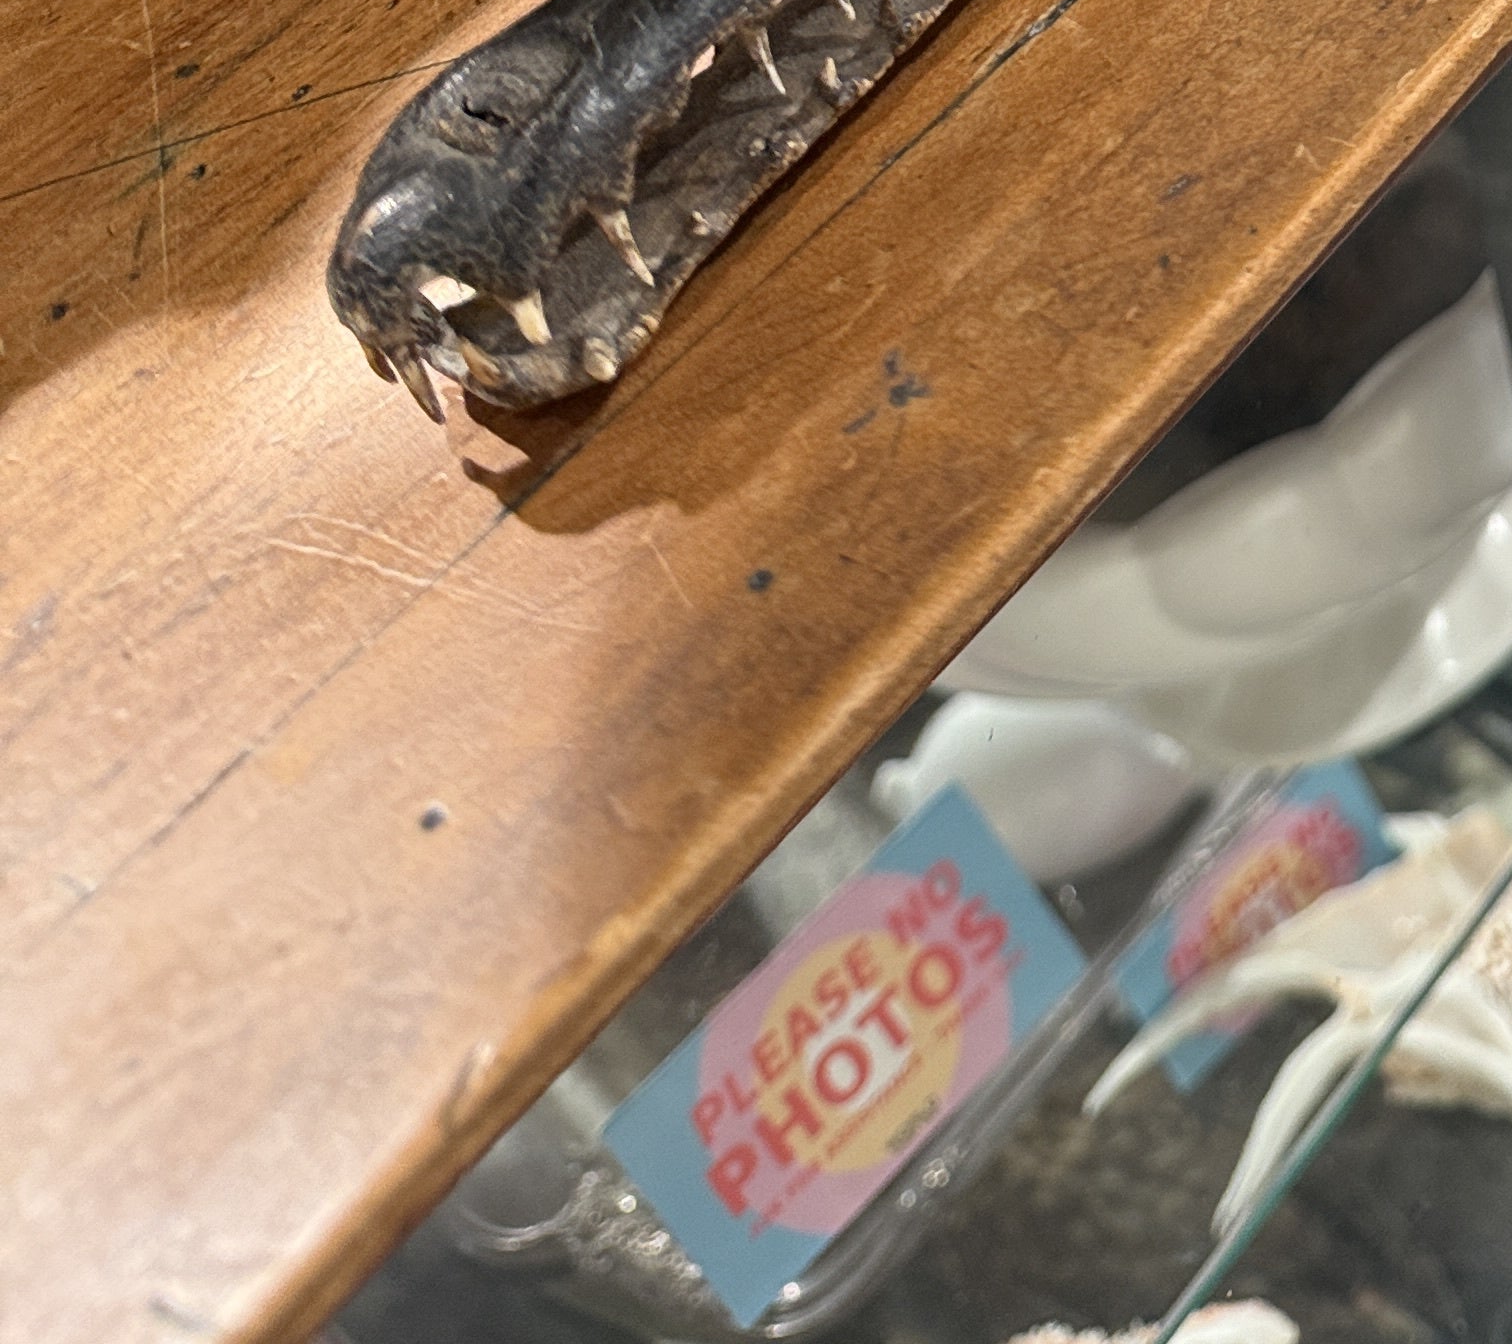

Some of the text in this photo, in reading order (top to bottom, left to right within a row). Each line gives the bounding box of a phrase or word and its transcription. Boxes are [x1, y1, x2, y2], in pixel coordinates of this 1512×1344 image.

[692, 934, 883, 1147] PLEASE
[886, 857, 963, 950] NO
[706, 893, 1010, 1217] PHOTOS
